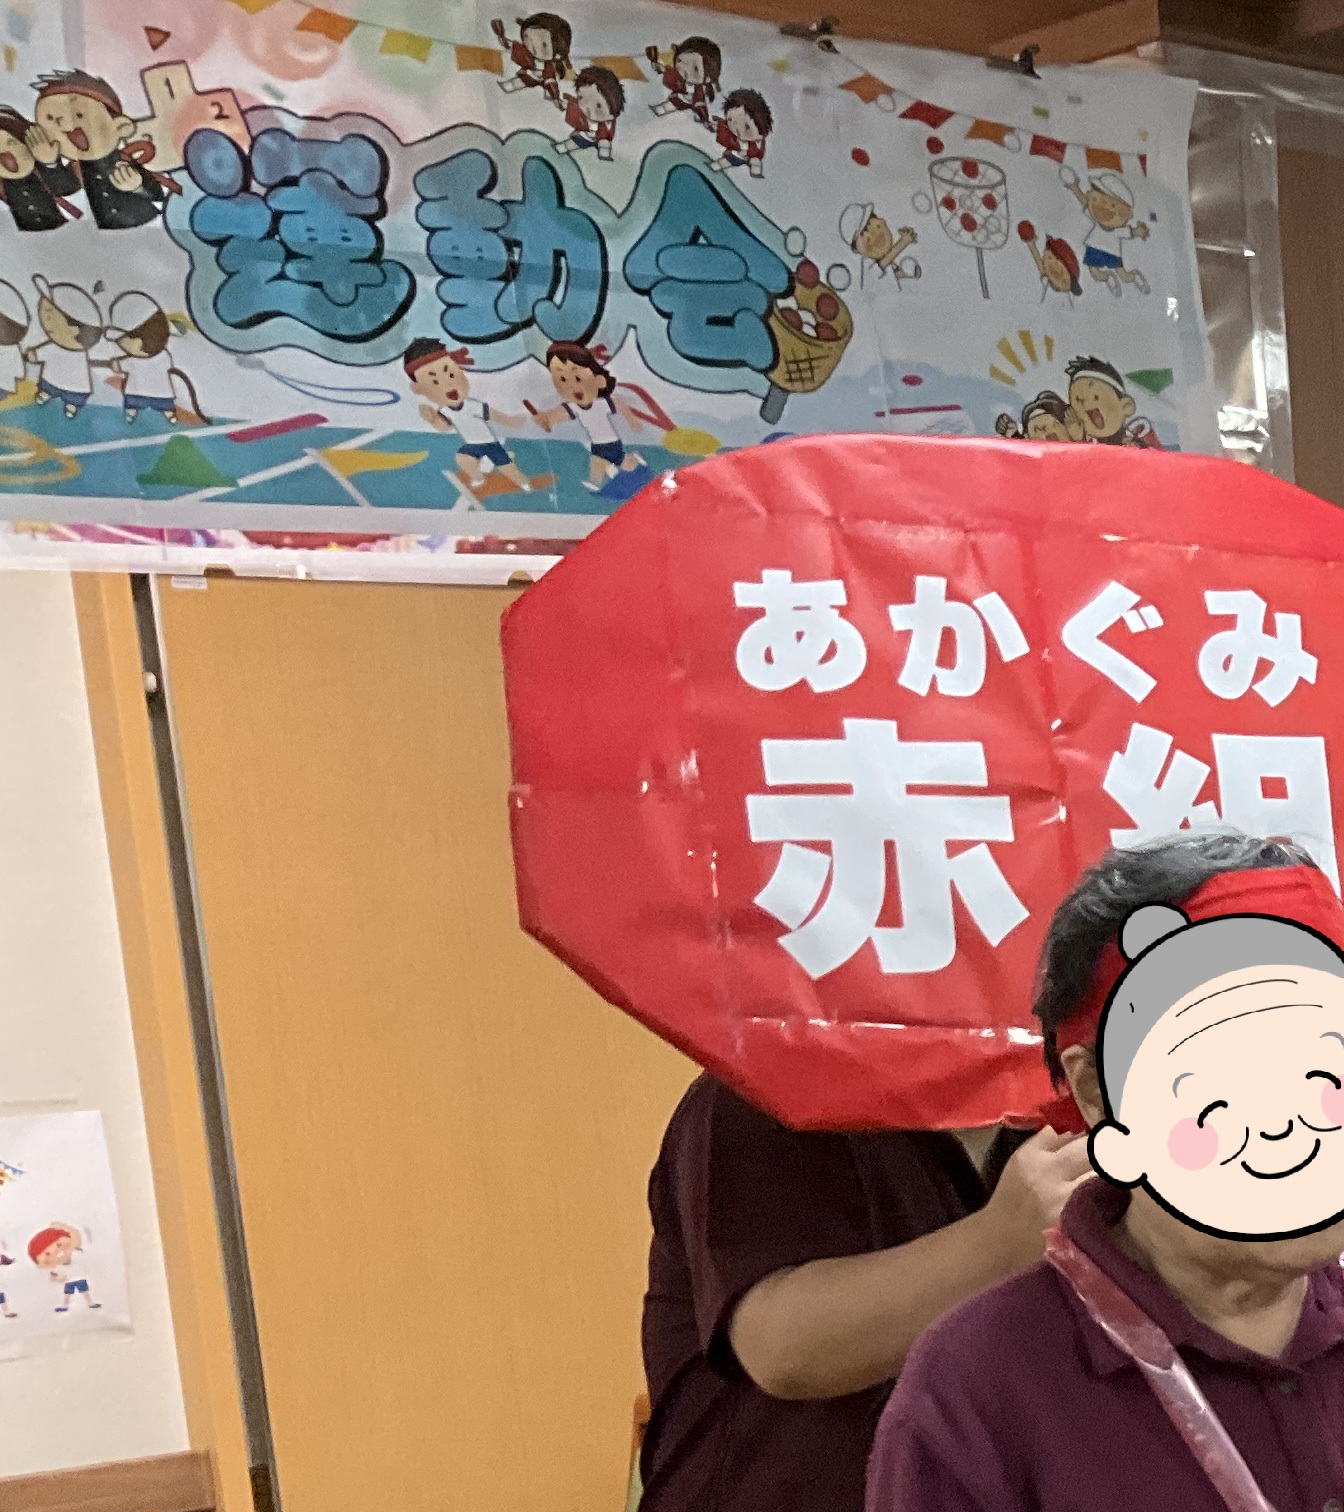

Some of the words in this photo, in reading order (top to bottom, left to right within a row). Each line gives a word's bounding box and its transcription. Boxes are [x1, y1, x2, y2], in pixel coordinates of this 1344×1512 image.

[164, 77, 175, 99] 1
[210, 101, 230, 120] 2
[182, 126, 796, 373] 運動会
[733, 568, 1319, 707] あかぐみ
